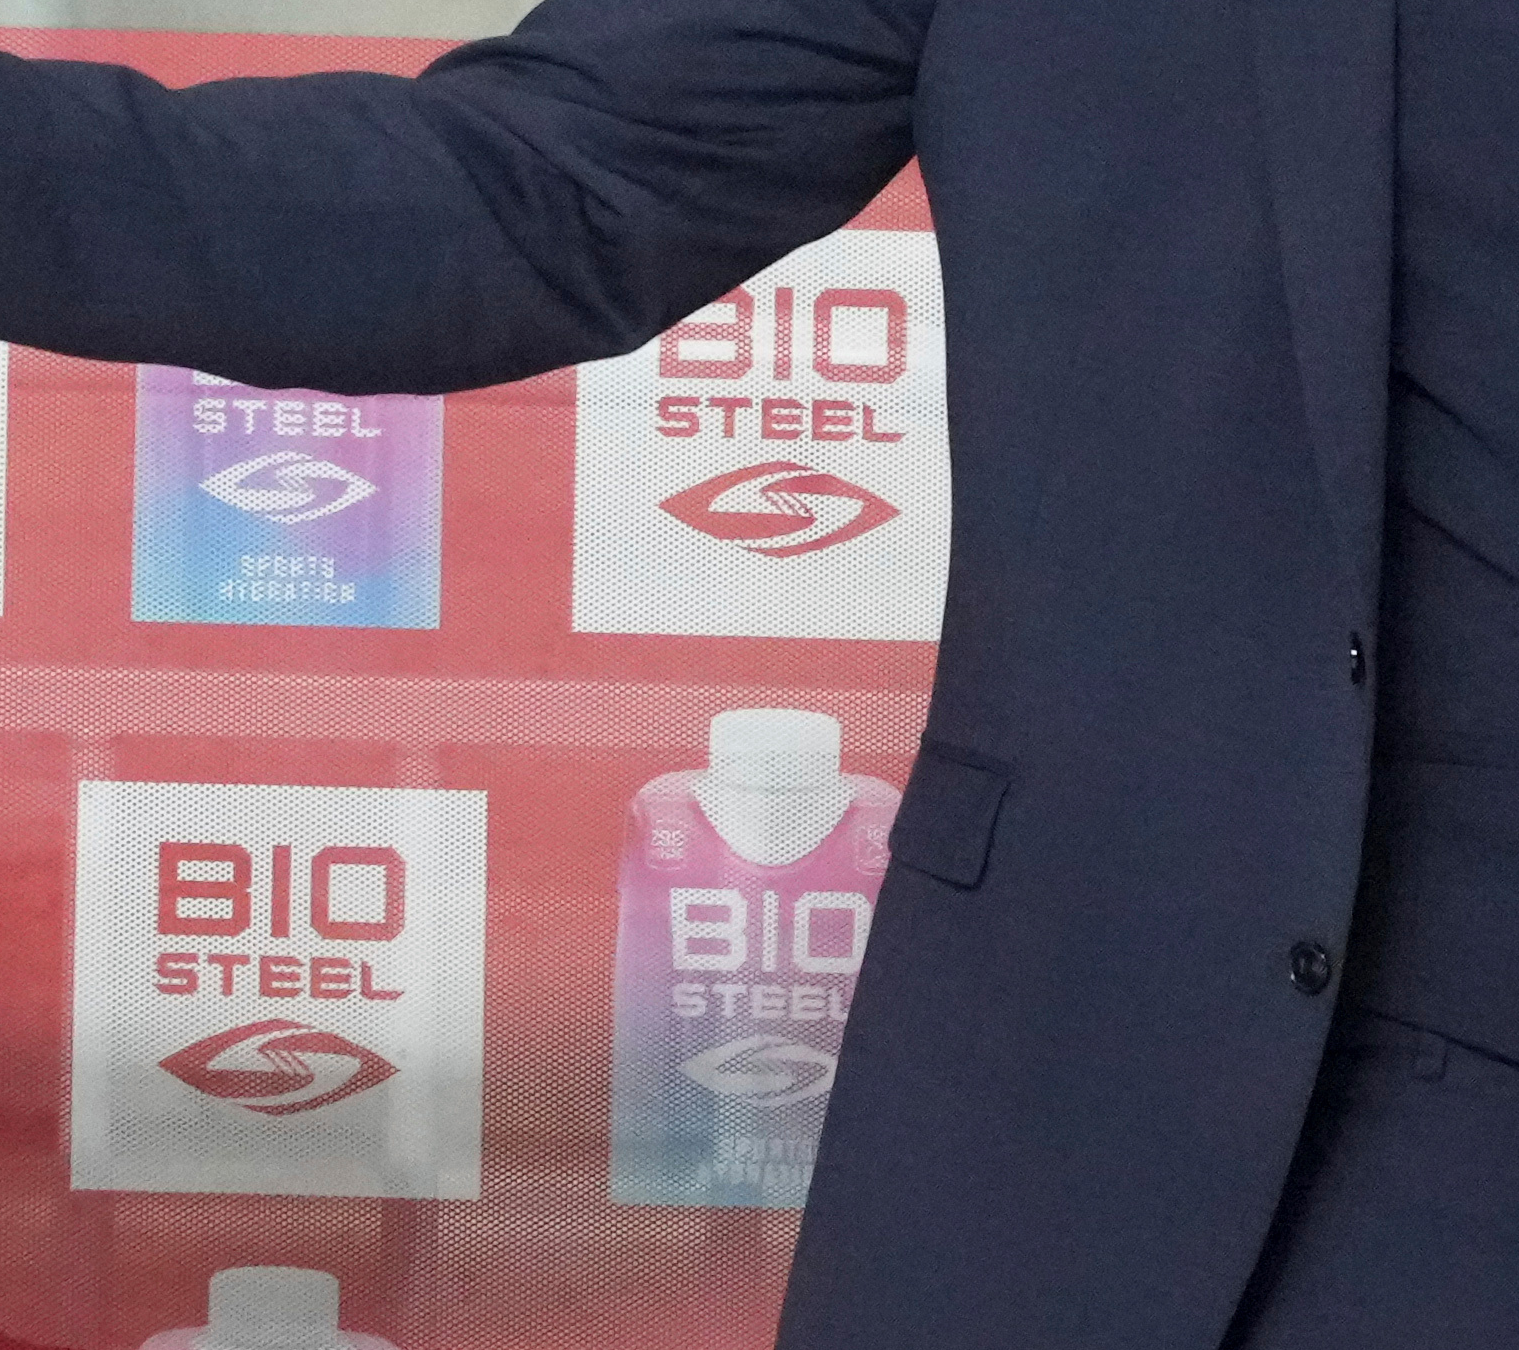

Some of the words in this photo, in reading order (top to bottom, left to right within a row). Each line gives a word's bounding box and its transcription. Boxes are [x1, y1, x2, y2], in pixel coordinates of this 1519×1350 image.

[659, 287, 908, 382] BIO
[193, 398, 382, 439] STEEL
[656, 397, 905, 443] STEEL
[157, 841, 406, 942] BIO
[669, 888, 872, 976] BIO
[154, 952, 404, 1002] STEEL
